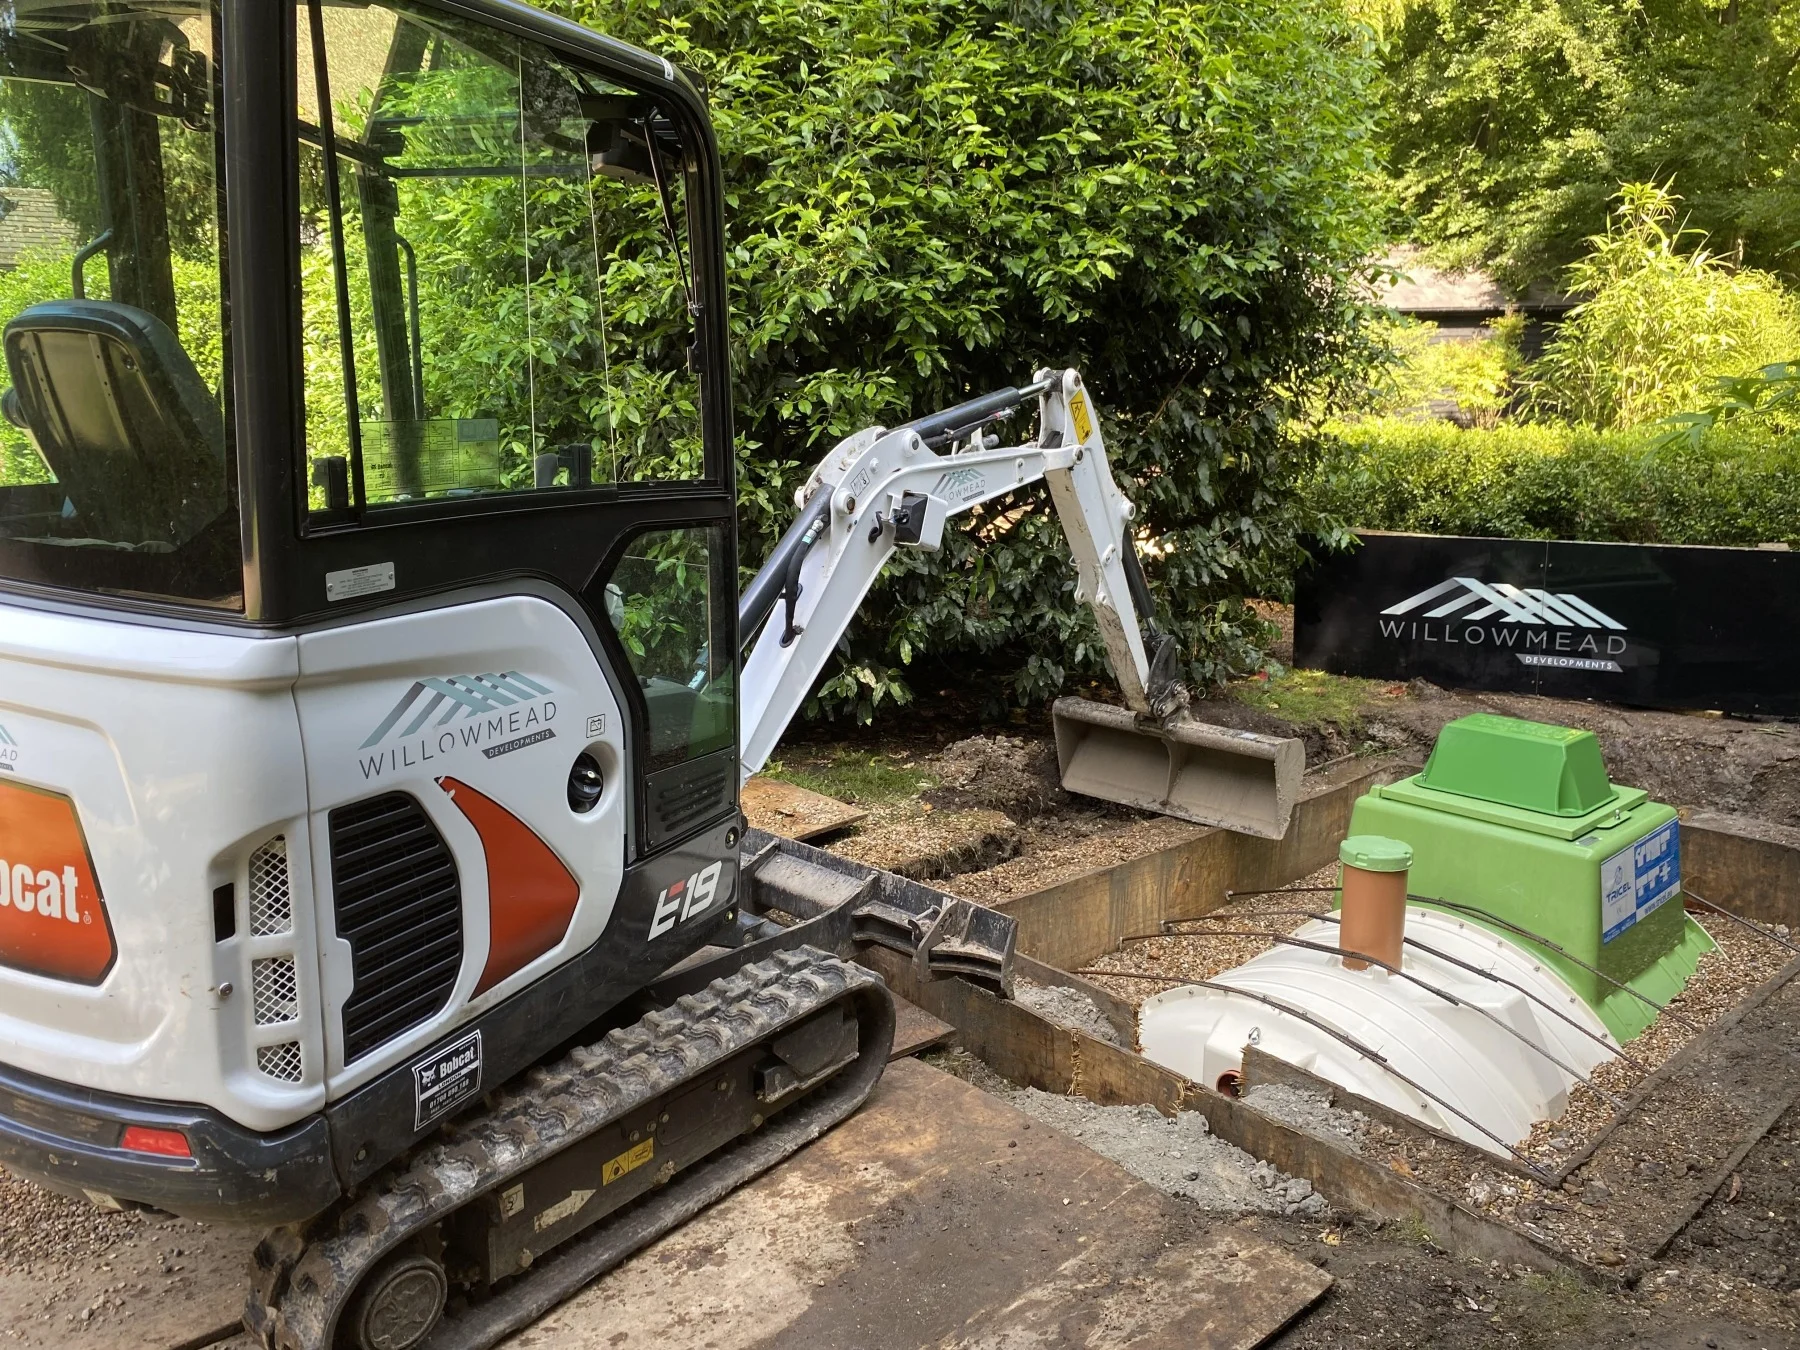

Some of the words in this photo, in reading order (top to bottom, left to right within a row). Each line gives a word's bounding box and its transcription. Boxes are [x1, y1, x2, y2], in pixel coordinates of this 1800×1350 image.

[943, 479, 986, 502] LOWMEAD
[1379, 619, 1628, 655] WILLOWMEAD
[1525, 656, 1613, 670] DEVELOPMENTS
[359, 701, 557, 780] WILLOWMEAD
[489, 730, 551, 757] DEVELOPMENTS
[647, 860, 722, 942] E19
[1605, 882, 1632, 903] TRICEL
[440, 1046, 475, 1079] Bobcat
[438, 1072, 462, 1089] LONDON
